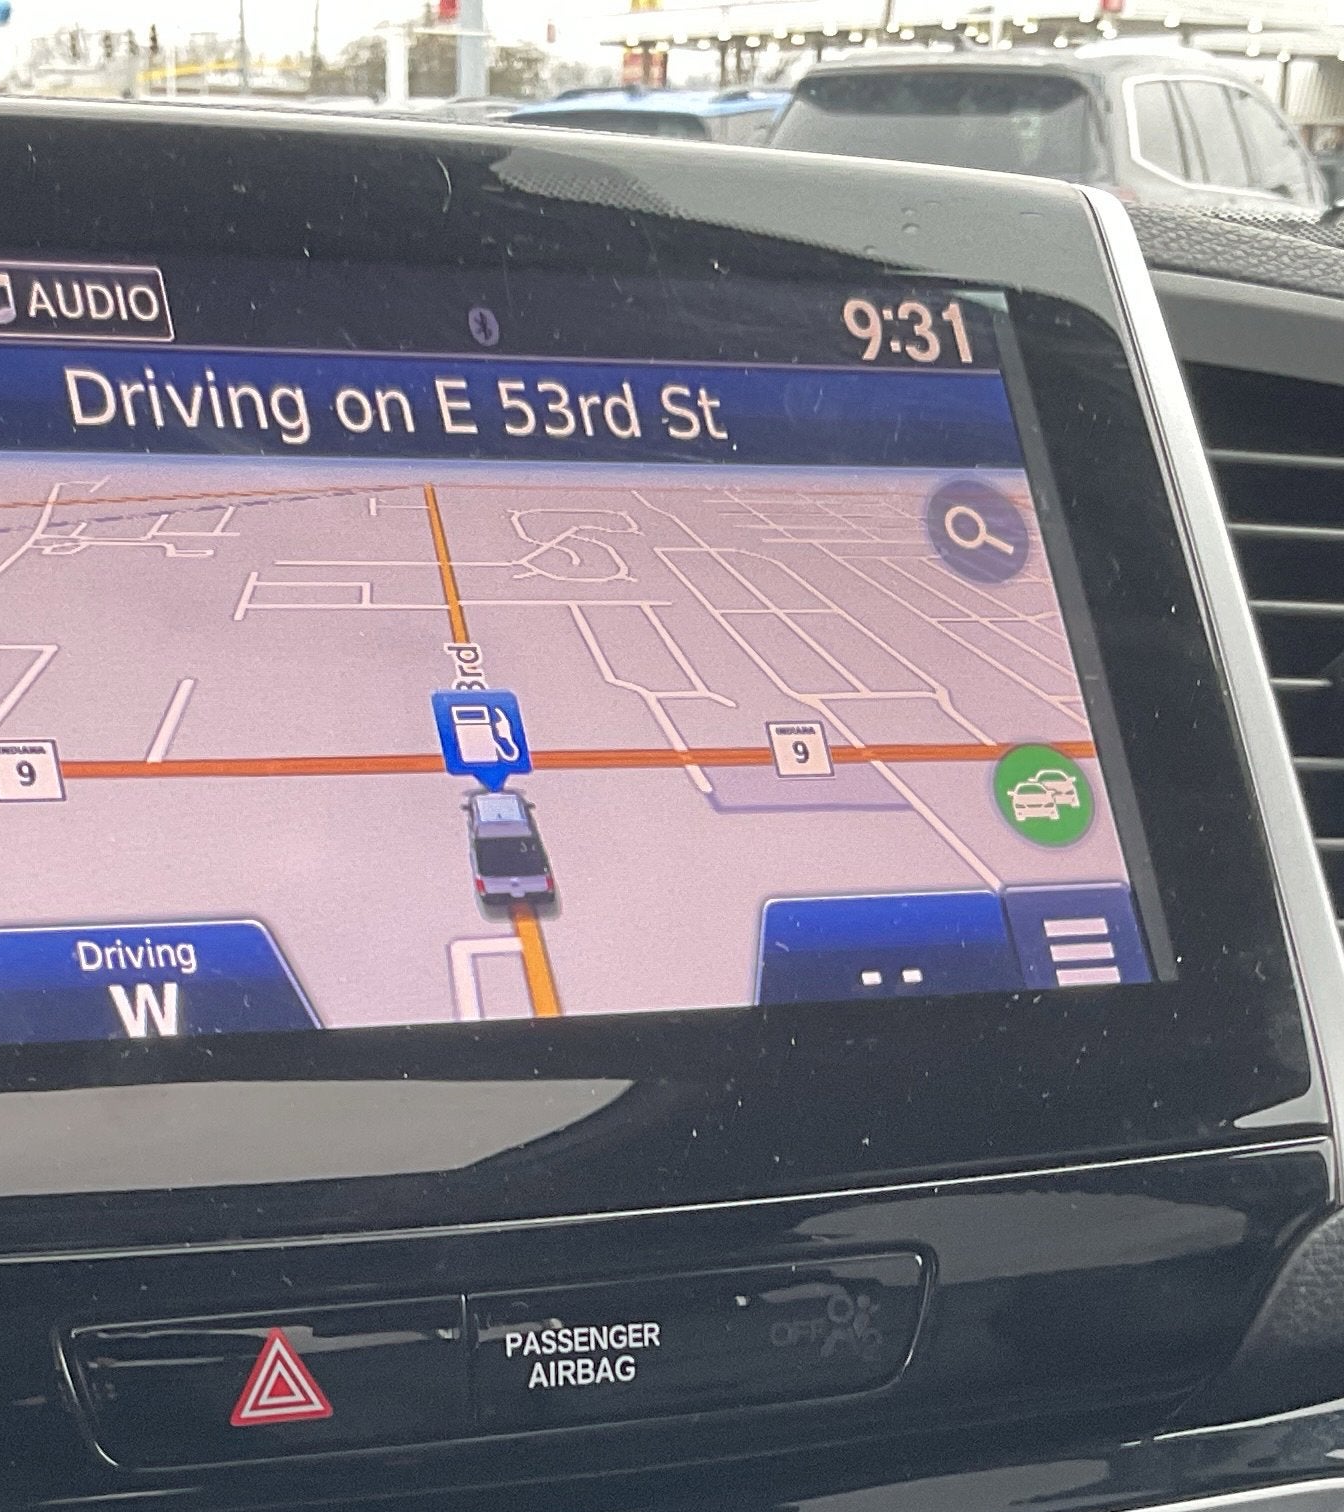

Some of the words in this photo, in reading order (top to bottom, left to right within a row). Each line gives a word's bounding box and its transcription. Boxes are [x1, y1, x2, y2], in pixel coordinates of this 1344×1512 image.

[27, 281, 159, 323] AUDIO
[841, 297, 974, 364] 9:31
[64, 365, 312, 444] Driving
[336, 384, 415, 433] on
[435, 378, 478, 436] E
[497, 379, 642, 439] 53rd
[660, 383, 729, 442] St
[792, 741, 809, 764] 9
[16, 760, 36, 787] 9
[77, 938, 197, 974] Driving
[109, 982, 178, 1038] W
[505, 1322, 661, 1357] PASSENGER
[528, 1356, 637, 1388] AIRBAG
